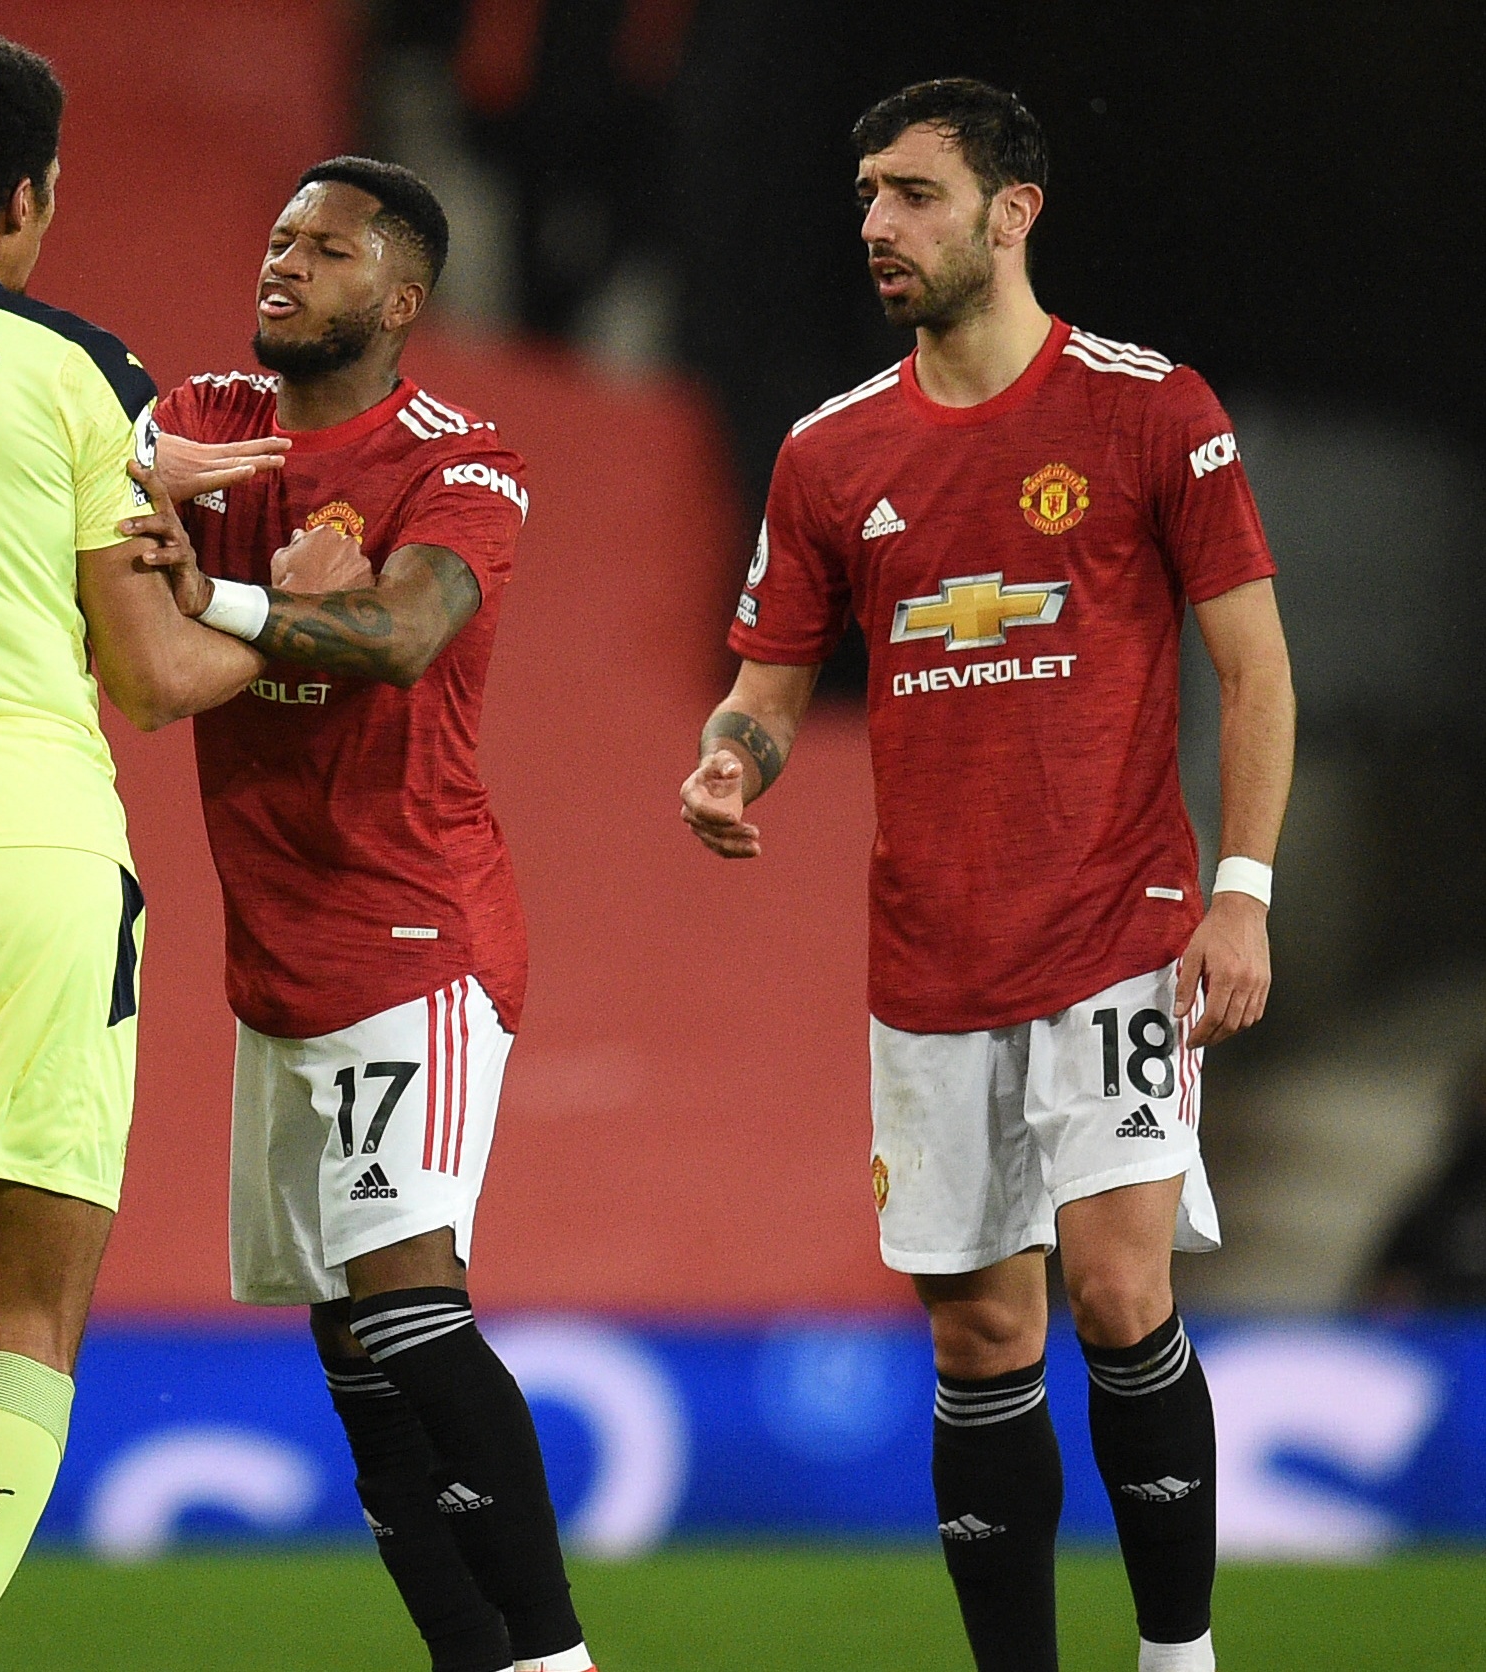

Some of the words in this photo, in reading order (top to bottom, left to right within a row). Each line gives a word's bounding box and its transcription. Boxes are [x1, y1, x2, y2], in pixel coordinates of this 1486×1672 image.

[1189, 432, 1241, 479] KOH
[861, 518, 907, 541] adidas
[1034, 517, 1074, 530] UNITED
[892, 654, 1078, 697] CHEVROLET
[1091, 1006, 1176, 1099] 18
[333, 1060, 422, 1159] 17
[1115, 1126, 1166, 1140] adidas
[349, 1186, 398, 1201] adidas
